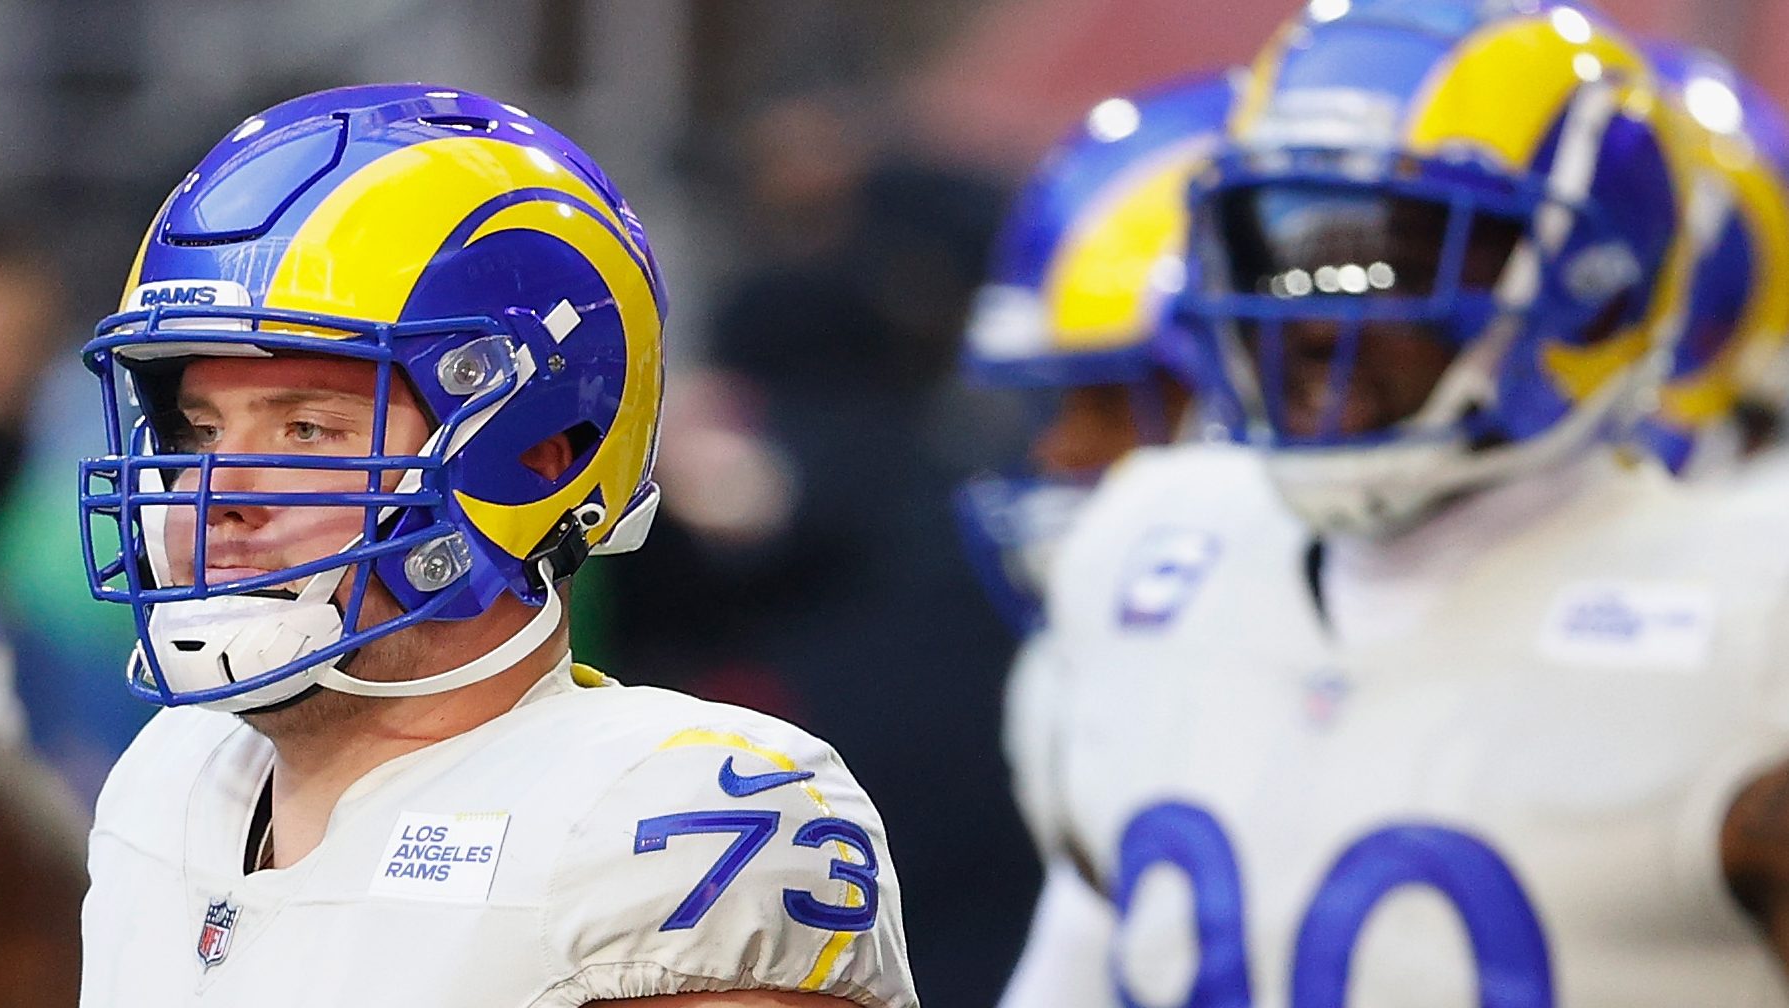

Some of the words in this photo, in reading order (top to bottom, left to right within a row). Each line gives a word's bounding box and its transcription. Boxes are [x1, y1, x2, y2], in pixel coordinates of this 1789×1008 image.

[141, 286, 217, 306] RAMS
[401, 825, 448, 843] LOS
[393, 844, 493, 863] ANGELES
[385, 862, 451, 881] RAMS
[634, 810, 879, 932] 73
